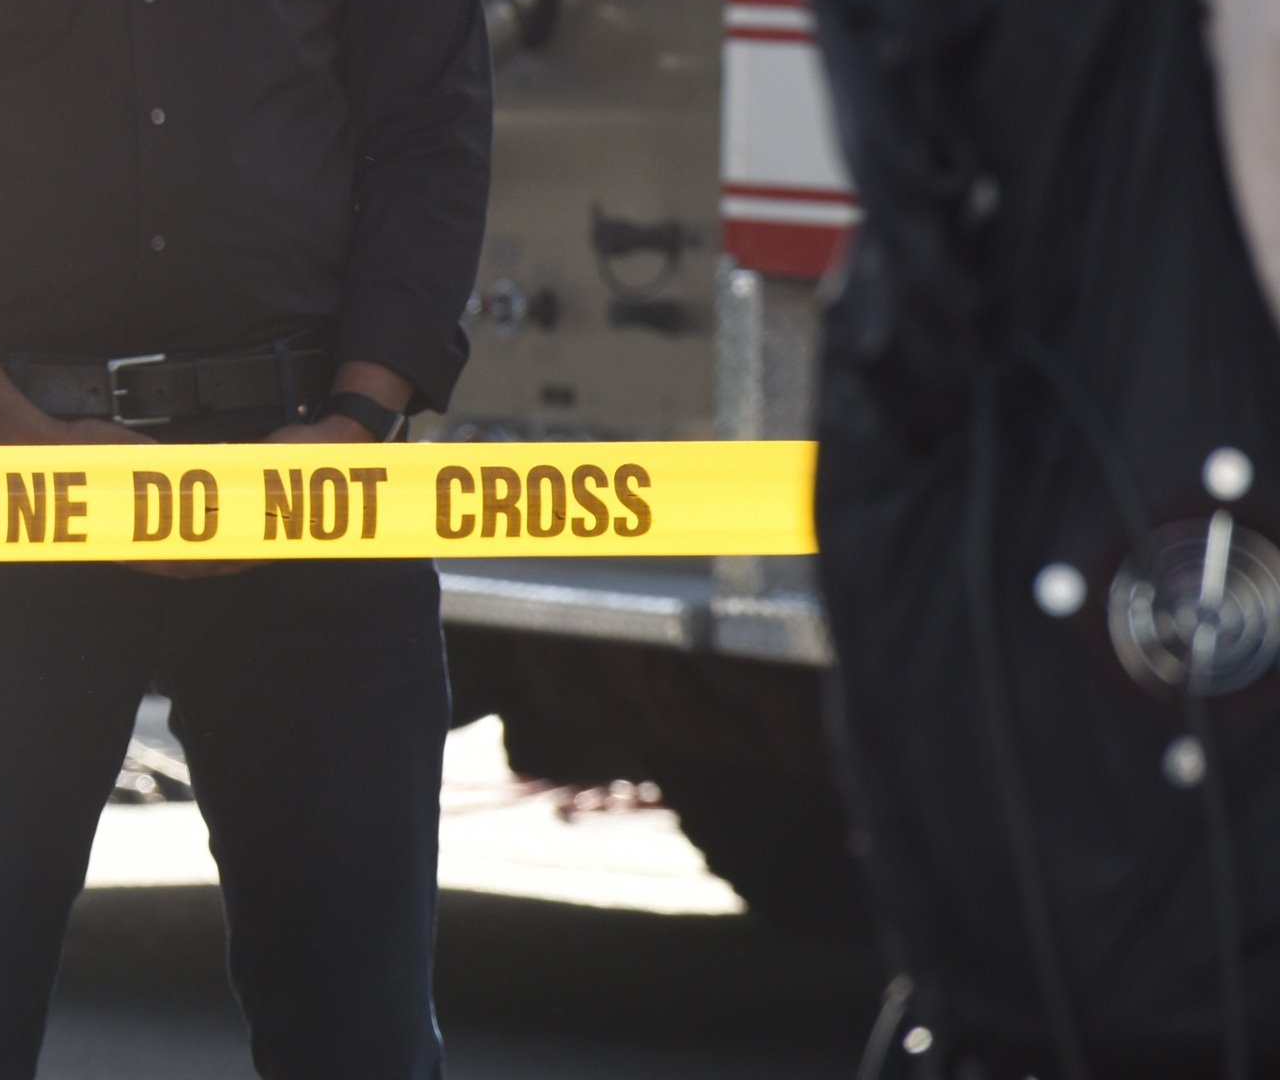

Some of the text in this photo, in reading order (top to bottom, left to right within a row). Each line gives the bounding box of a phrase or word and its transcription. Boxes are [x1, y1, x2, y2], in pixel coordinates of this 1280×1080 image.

[132, 469, 219, 542] DO
[263, 467, 388, 541] NOT
[436, 463, 652, 539] CROSS
